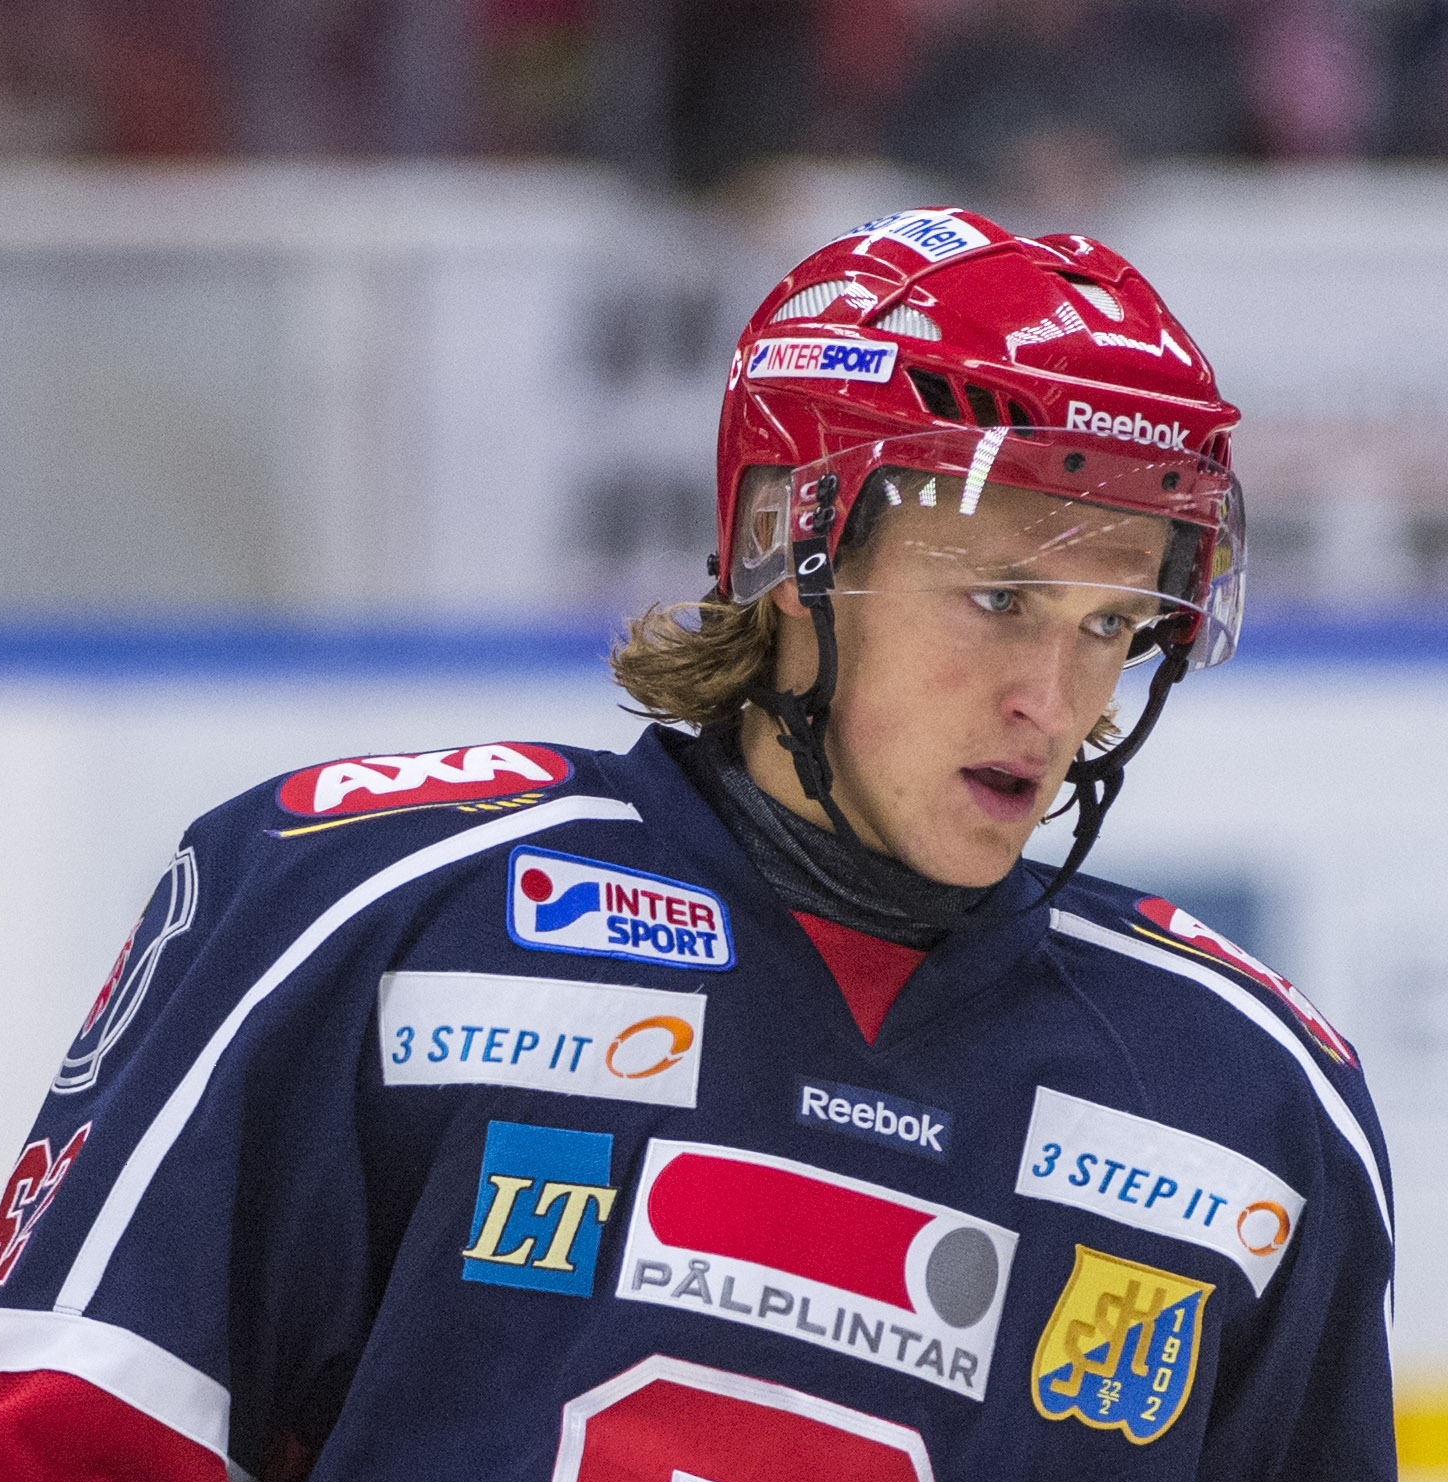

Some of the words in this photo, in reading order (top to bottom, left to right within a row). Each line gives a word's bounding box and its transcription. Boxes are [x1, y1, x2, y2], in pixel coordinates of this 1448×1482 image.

[767, 343, 888, 375] INTERSPORT
[1066, 399, 1191, 454] Reebok
[314, 744, 554, 812] AXA
[605, 882, 717, 931] INTER
[607, 917, 719, 959] SPORT
[391, 1026, 415, 1065] 3
[427, 1025, 540, 1067] STEP
[548, 1035, 593, 1073] IT
[801, 1085, 945, 1152] Reebok
[1032, 1142, 1062, 1178] 3
[1068, 1151, 1178, 1209] STEP
[1183, 1188, 1228, 1228] IT
[461, 1174, 618, 1273] LT
[631, 1258, 979, 1388] PÅLPLINTAR
